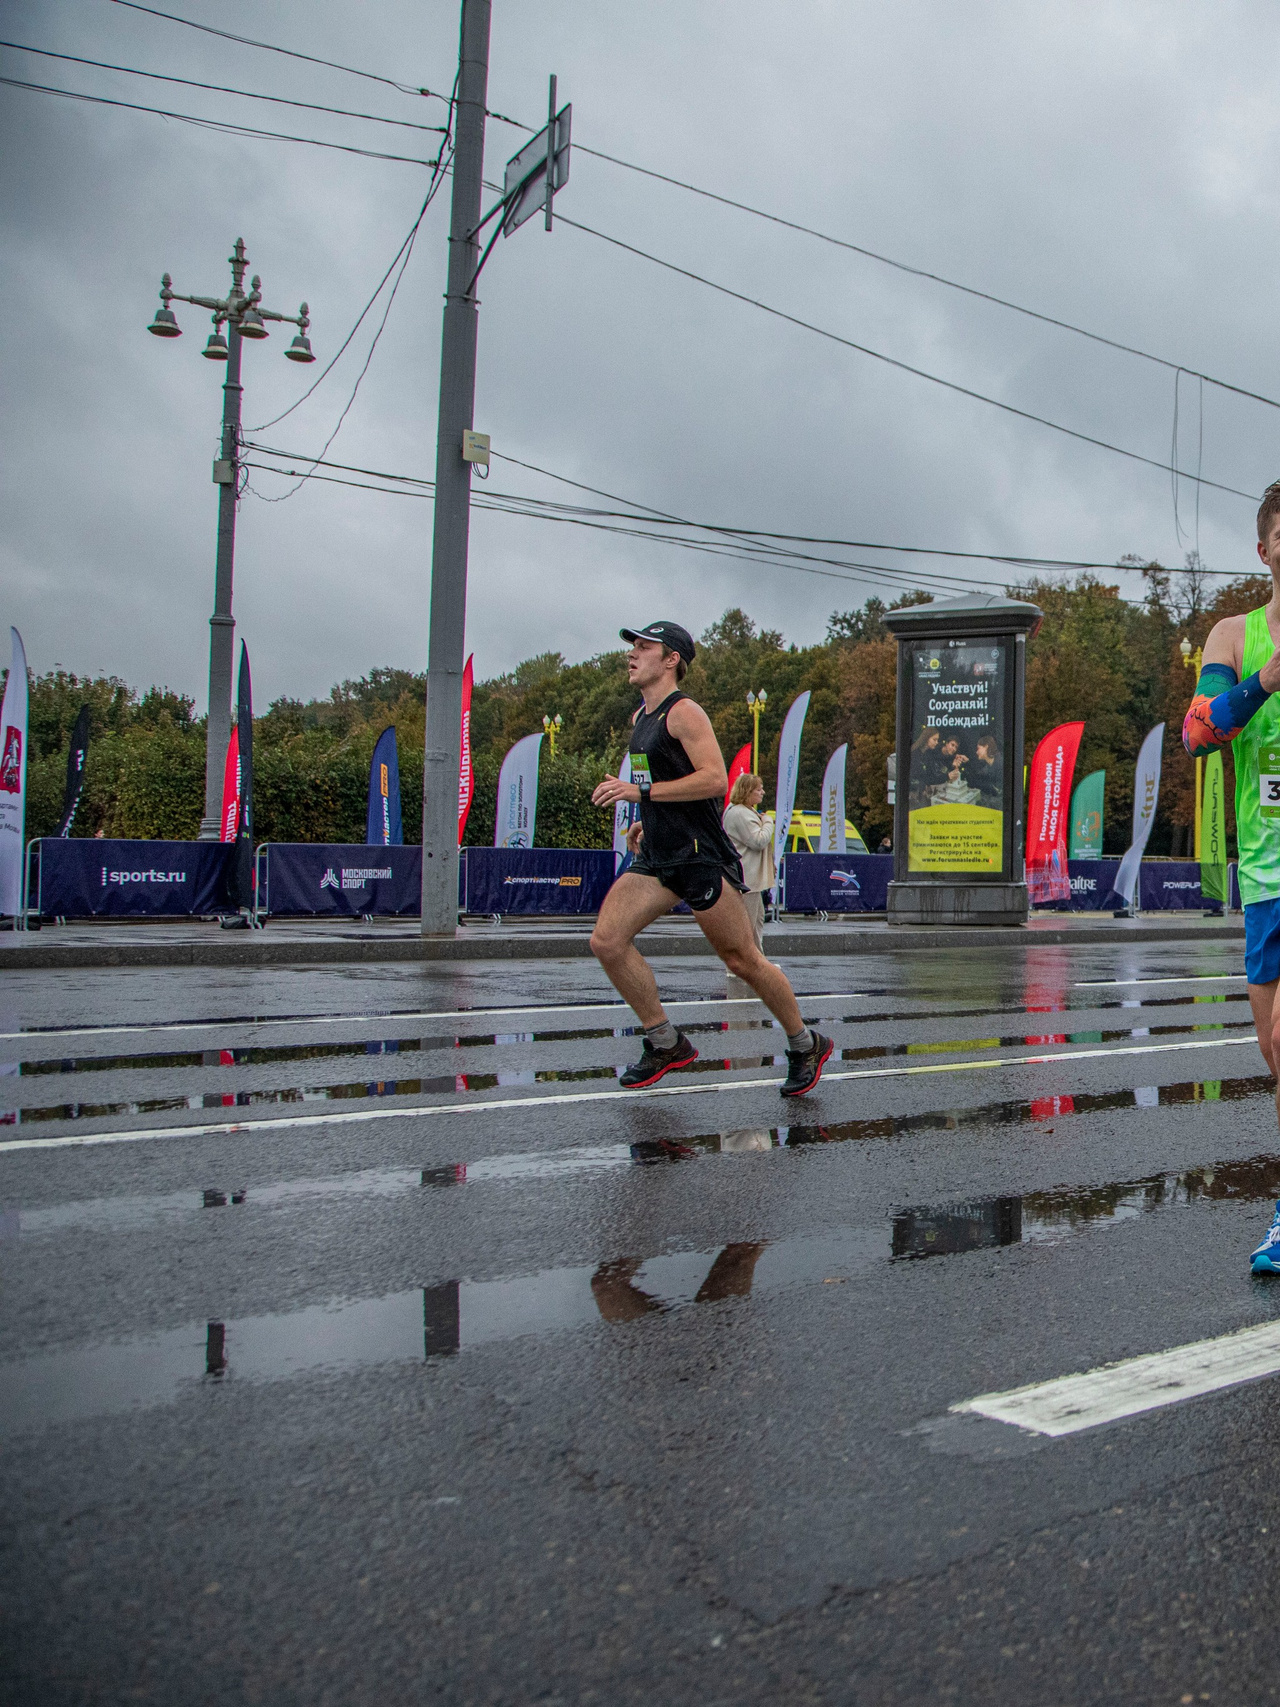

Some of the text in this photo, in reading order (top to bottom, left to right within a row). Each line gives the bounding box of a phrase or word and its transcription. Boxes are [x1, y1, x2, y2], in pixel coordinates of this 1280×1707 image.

[932, 681, 989, 696] Участвуй!
[928, 697, 988, 713] Сохраняй!
[926, 713, 989, 728] Побеждай!
[1049, 745, 1064, 842] «МОЯ СТОЛИЦА»
[508, 784, 518, 829] pharmeco
[1039, 763, 1053, 841] Полумарафон
[109, 869, 186, 885] sports.ru
[342, 866, 392, 879] МОСКОВСКИЙ
[342, 879, 366, 889] СПОРТ
[561, 877, 580, 885] PRO
